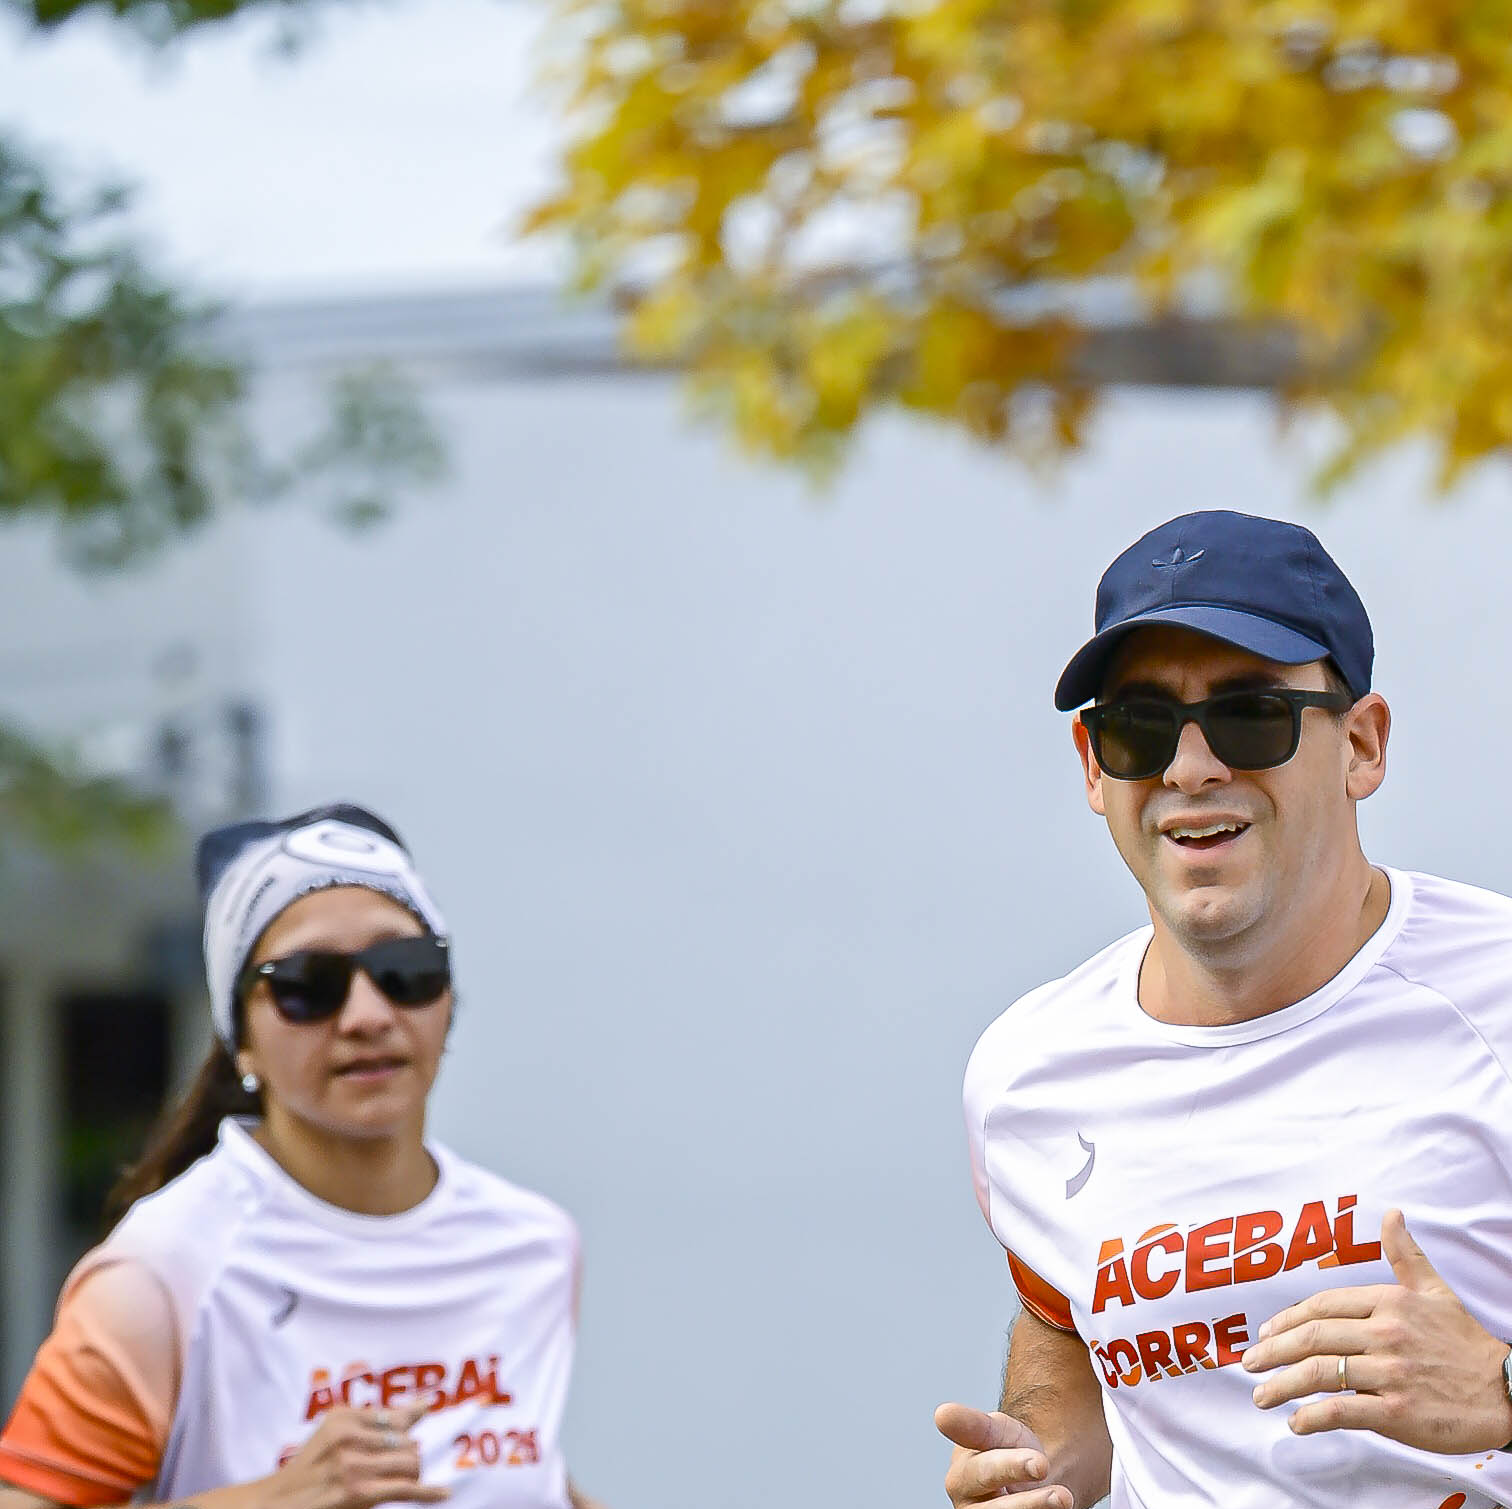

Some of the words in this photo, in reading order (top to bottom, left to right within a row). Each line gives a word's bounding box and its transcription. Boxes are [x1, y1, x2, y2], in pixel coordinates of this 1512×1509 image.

[1091, 1193, 1382, 1314] ACEBAL
[303, 1354, 512, 1421] ACEBAL
[1089, 1312, 1249, 1389] CORRE
